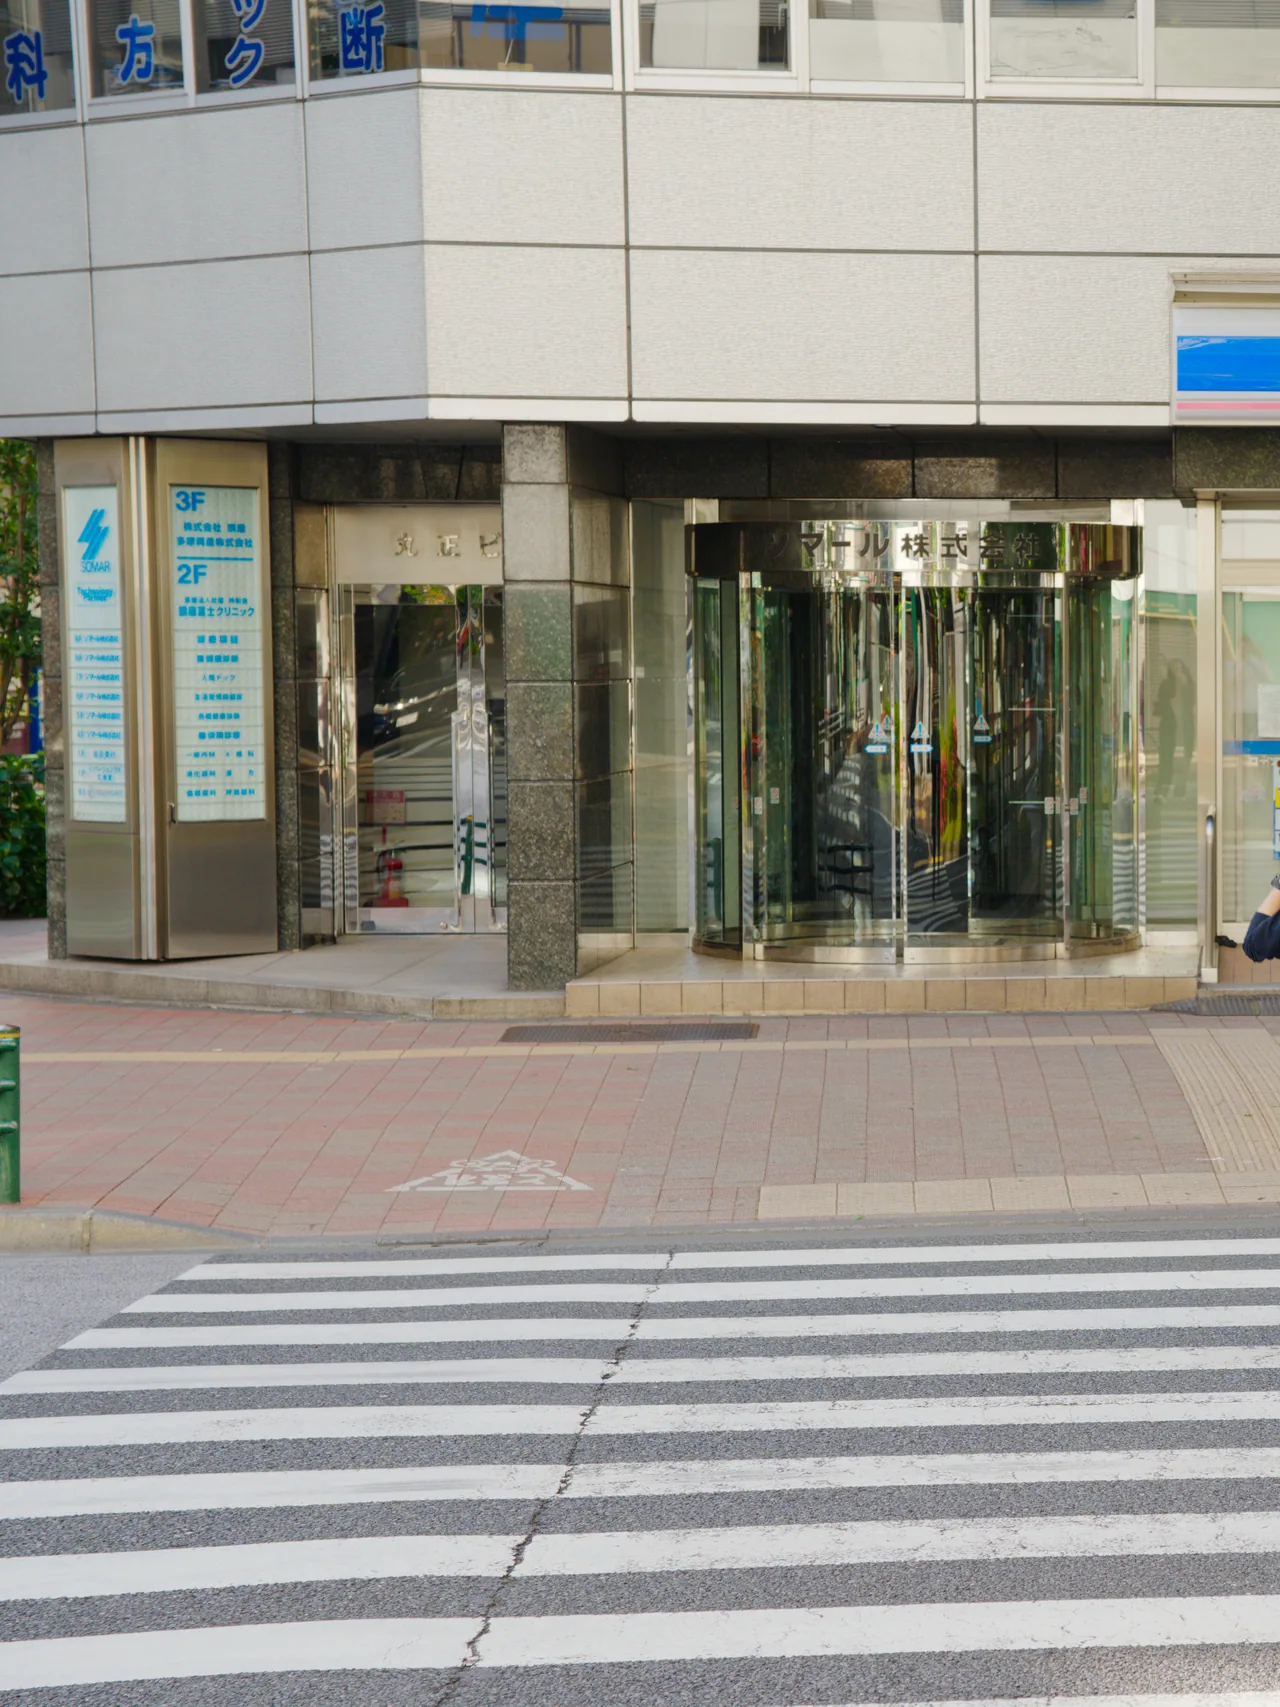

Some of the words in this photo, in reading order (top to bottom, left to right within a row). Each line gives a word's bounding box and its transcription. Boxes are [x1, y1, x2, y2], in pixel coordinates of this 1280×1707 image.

[116, 14, 156, 84] 方
[339, 2, 386, 74] 断
[4, 30, 49, 102] 科
[175, 490, 206, 512] 3F
[772, 532, 1041, 560] ソマール株式会社
[80, 560, 111, 573] SOMAR
[177, 563, 208, 585] 2F
